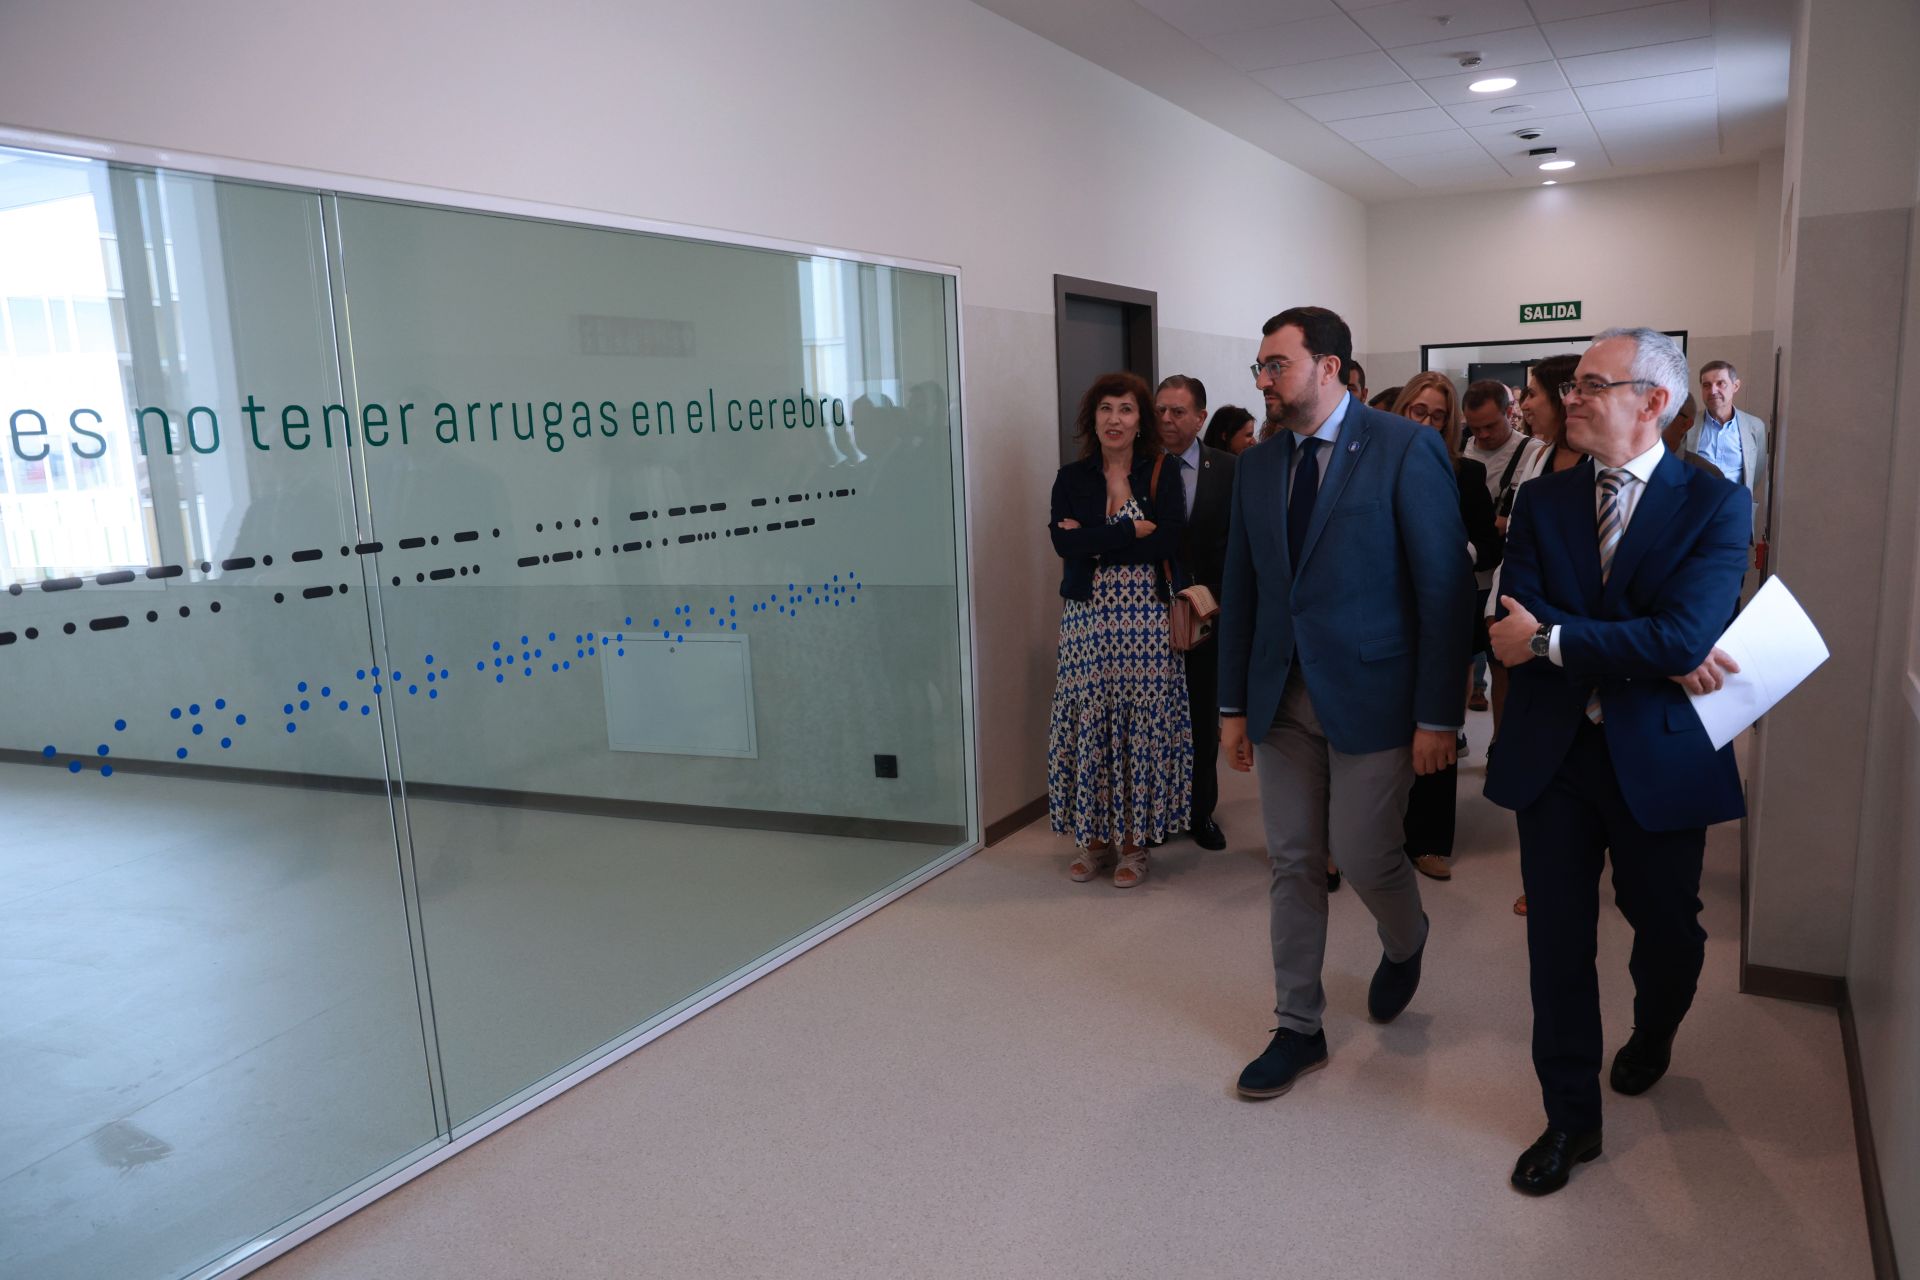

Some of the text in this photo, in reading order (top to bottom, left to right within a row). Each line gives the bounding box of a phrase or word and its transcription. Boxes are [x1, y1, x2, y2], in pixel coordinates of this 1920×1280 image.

[1524, 304, 1577, 320] SALIDA
[9, 387, 855, 462] es no tener arrugas en el cerebro.
